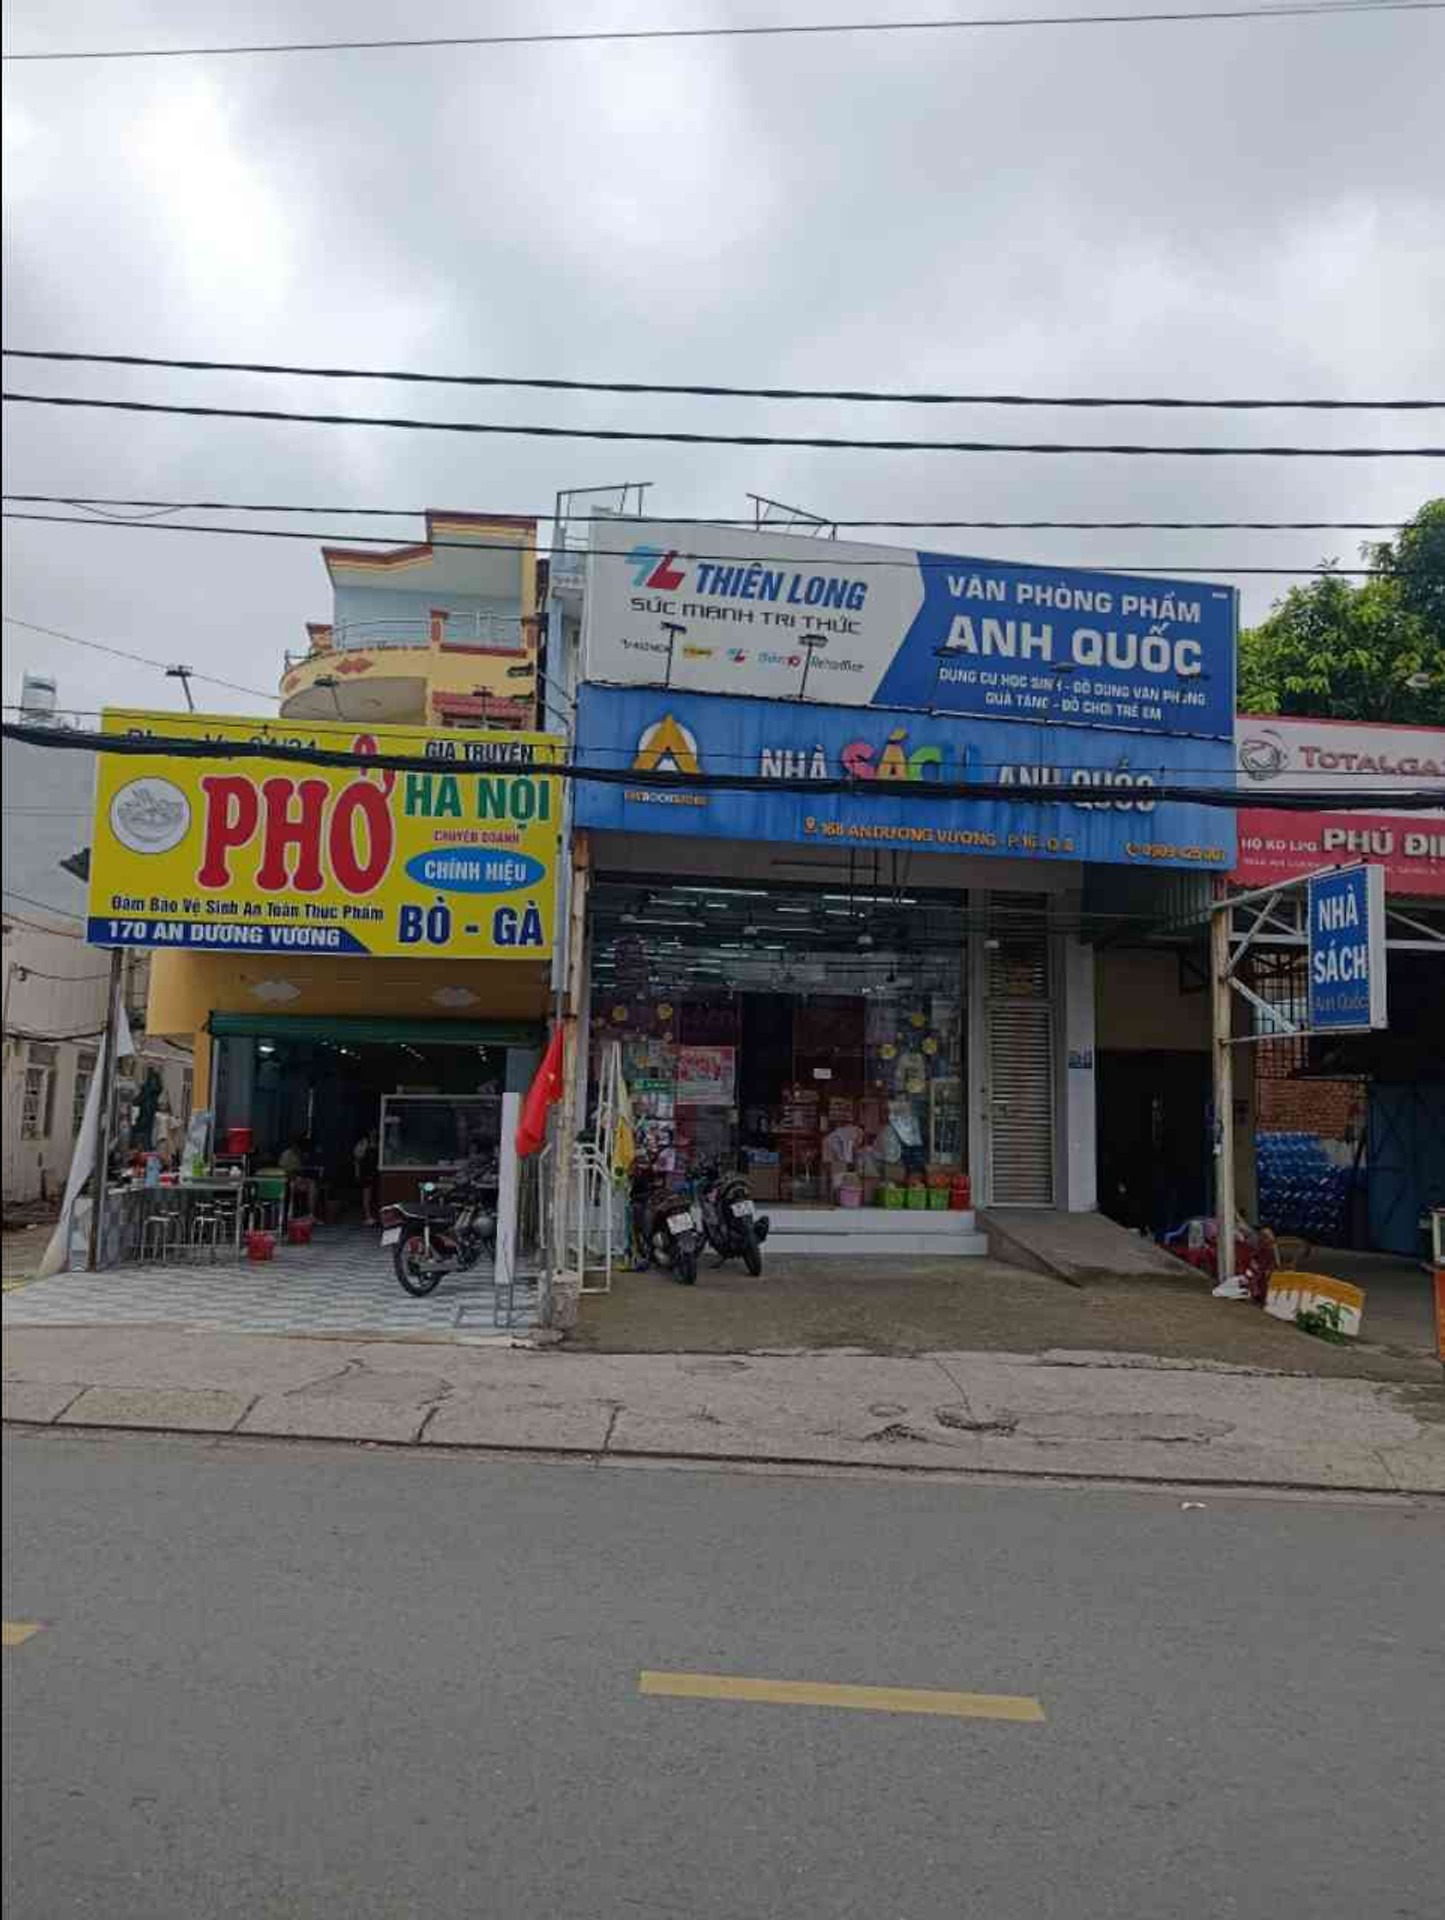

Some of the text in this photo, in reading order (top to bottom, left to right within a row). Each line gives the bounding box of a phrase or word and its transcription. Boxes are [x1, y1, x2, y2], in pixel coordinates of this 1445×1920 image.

[696, 562, 868, 611] THIÊN LONG
[1016, 582, 1113, 614] PHÒNG
[1121, 591, 1201, 624] PHẨM
[630, 596, 677, 617] SỨC
[759, 611, 797, 628] TRI
[801, 614, 864, 635] THỨC
[945, 614, 1202, 676] ANH QUỐC
[760, 744, 828, 780] NHÀ
[1298, 745, 1445, 777] TOTALGA
[199, 733, 397, 897] PHỞ
[477, 770, 551, 829] NỘI
[1323, 826, 1394, 856] PHÚ
[424, 858, 527, 887] CHÍNH HIỆU
[206, 900, 238, 915] Sinh
[243, 901, 262, 916] An
[398, 896, 451, 944] BÒ
[493, 901, 543, 945] GÀ
[1318, 885, 1358, 932] NHÀ
[108, 921, 147, 939] 170
[153, 923, 184, 941] AN
[1313, 941, 1367, 983] SÁCH
